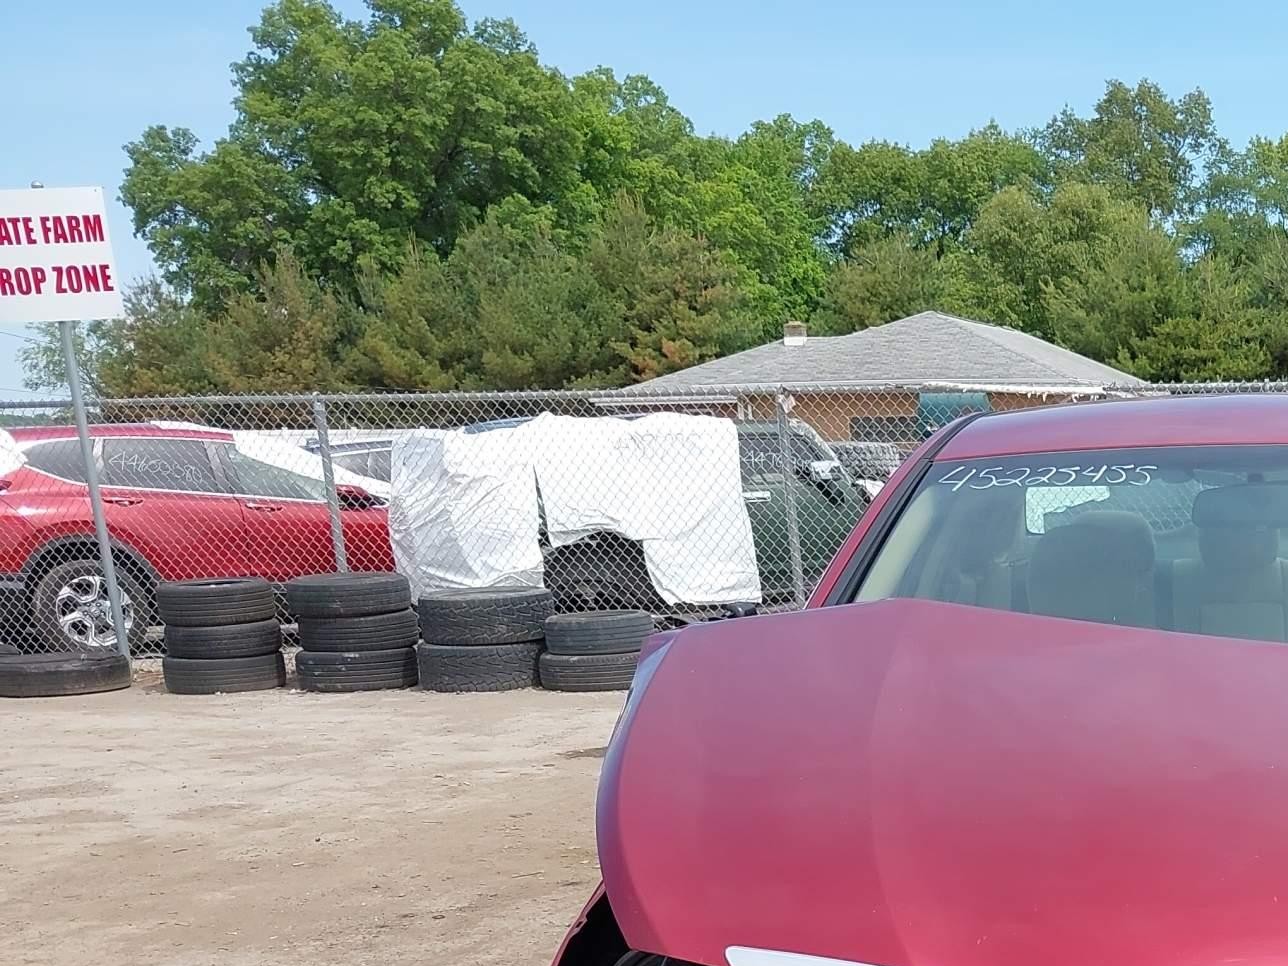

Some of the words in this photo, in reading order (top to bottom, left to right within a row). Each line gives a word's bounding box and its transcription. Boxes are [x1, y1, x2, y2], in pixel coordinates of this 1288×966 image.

[40, 214, 105, 245] FARM
[0, 267, 47, 296] ROP
[52, 264, 114, 294] ZONE
[938, 464, 1158, 492] 45225455
